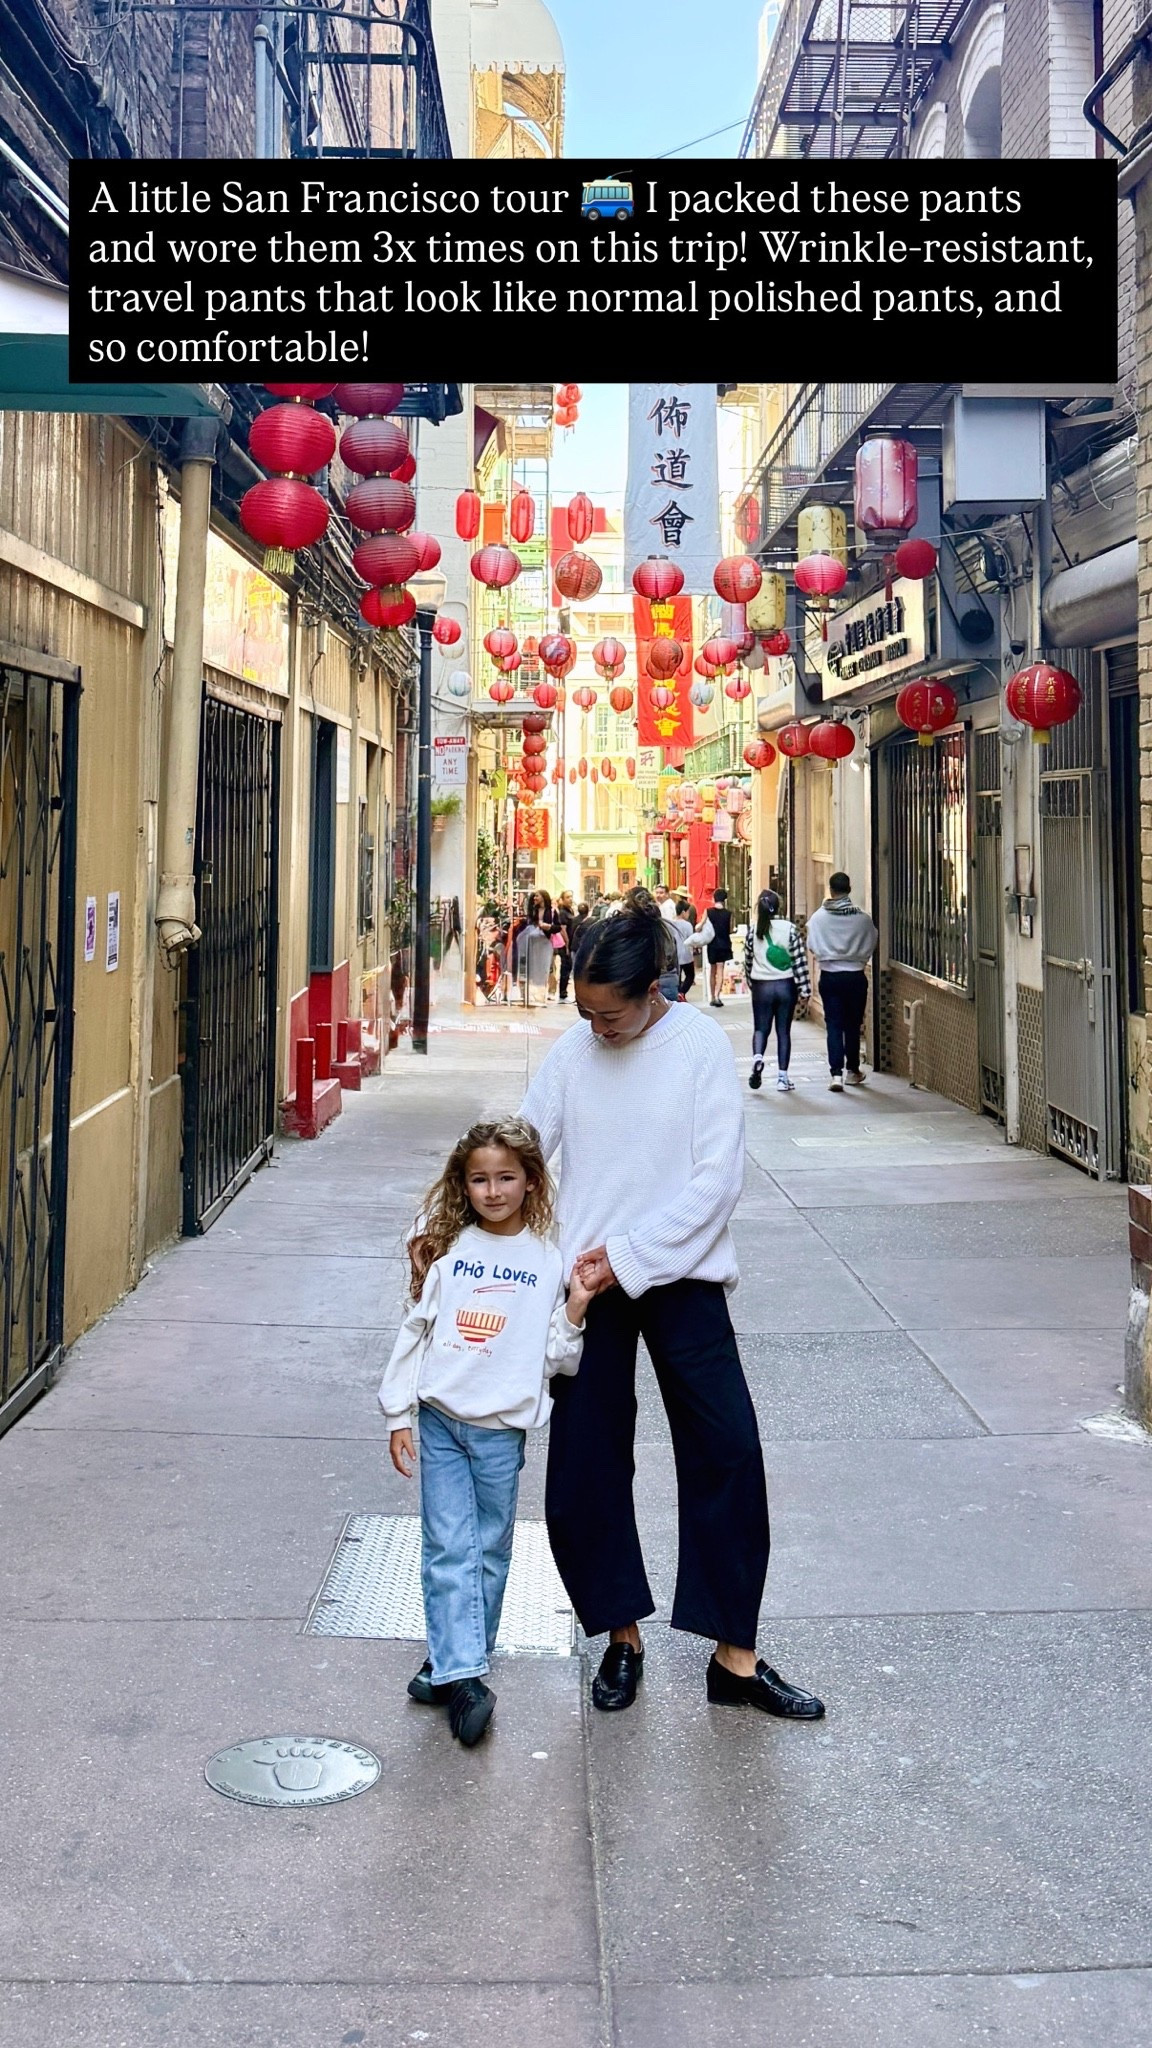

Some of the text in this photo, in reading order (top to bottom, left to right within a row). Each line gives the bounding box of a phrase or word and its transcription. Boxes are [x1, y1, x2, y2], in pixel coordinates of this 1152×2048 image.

[648, 383, 694, 548] 佈道會
[443, 758, 457, 766] ANY
[442, 767, 458, 775] TIME
[493, 1264, 537, 1288] LOVER
